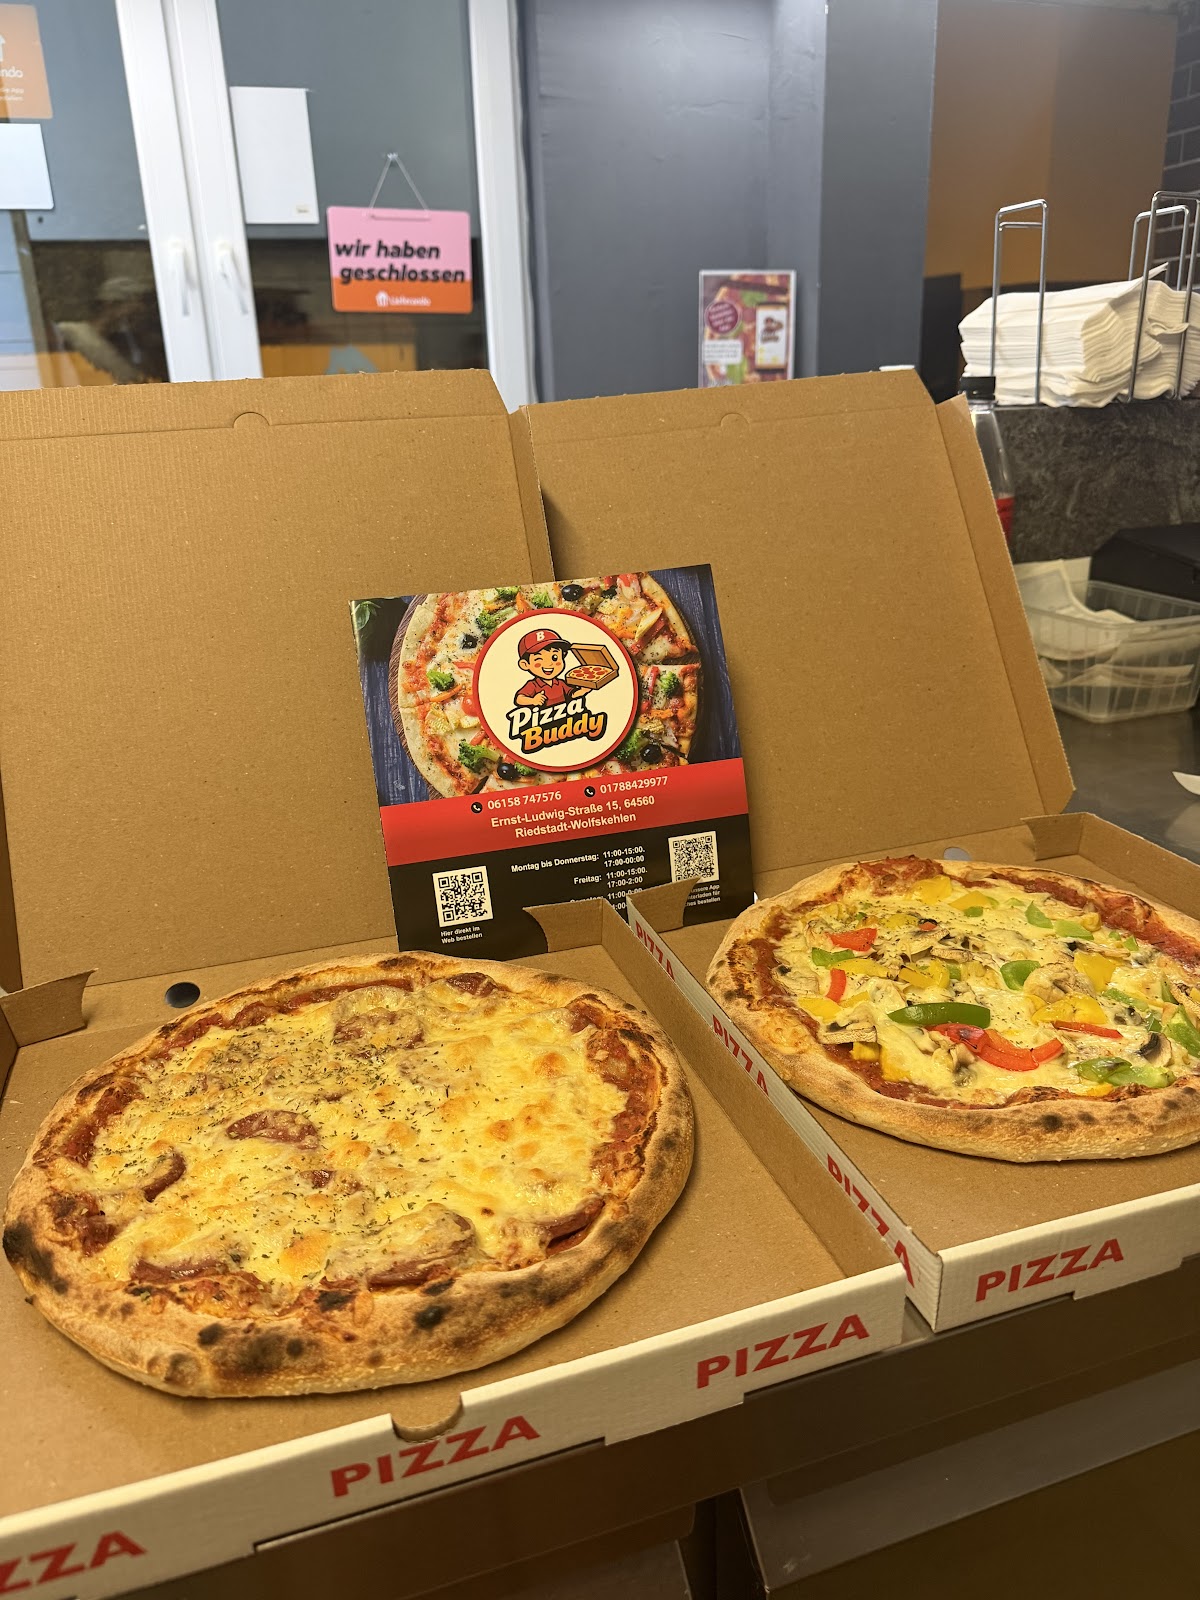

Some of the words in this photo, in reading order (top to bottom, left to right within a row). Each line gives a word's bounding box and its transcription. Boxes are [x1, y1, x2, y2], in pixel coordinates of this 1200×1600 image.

[335, 239, 371, 257] wir
[376, 239, 441, 259] haben
[340, 263, 466, 285] geschlossen
[535, 630, 546, 642] B
[508, 697, 585, 737] Pizza
[519, 713, 605, 751] Buddy
[487, 796, 521, 810] 06158
[522, 790, 562, 805] 747576
[599, 775, 668, 794] 01788429977
[490, 803, 604, 828] Ernst-Ludwig-Straße
[605, 800, 622, 811] 15,
[623, 795, 655, 809] 64560
[515, 813, 637, 839] Riedstadt-Wolfskehlen
[510, 861, 540, 873] Montag
[540, 860, 553, 868] bis
[554, 853, 600, 867] Donnerstag:
[603, 854, 645, 868] 17:00-00:00
[573, 874, 602, 885] Freitag:
[606, 876, 643, 889] 17:00-2:00
[440, 930, 454, 938] Hier
[454, 927, 472, 935] direkt
[455, 932, 483, 942] bestellen
[975, 1238, 1125, 1303] PIZZA
[696, 1313, 870, 1389] PIZZA
[330, 1414, 541, 1498] PIZZA
